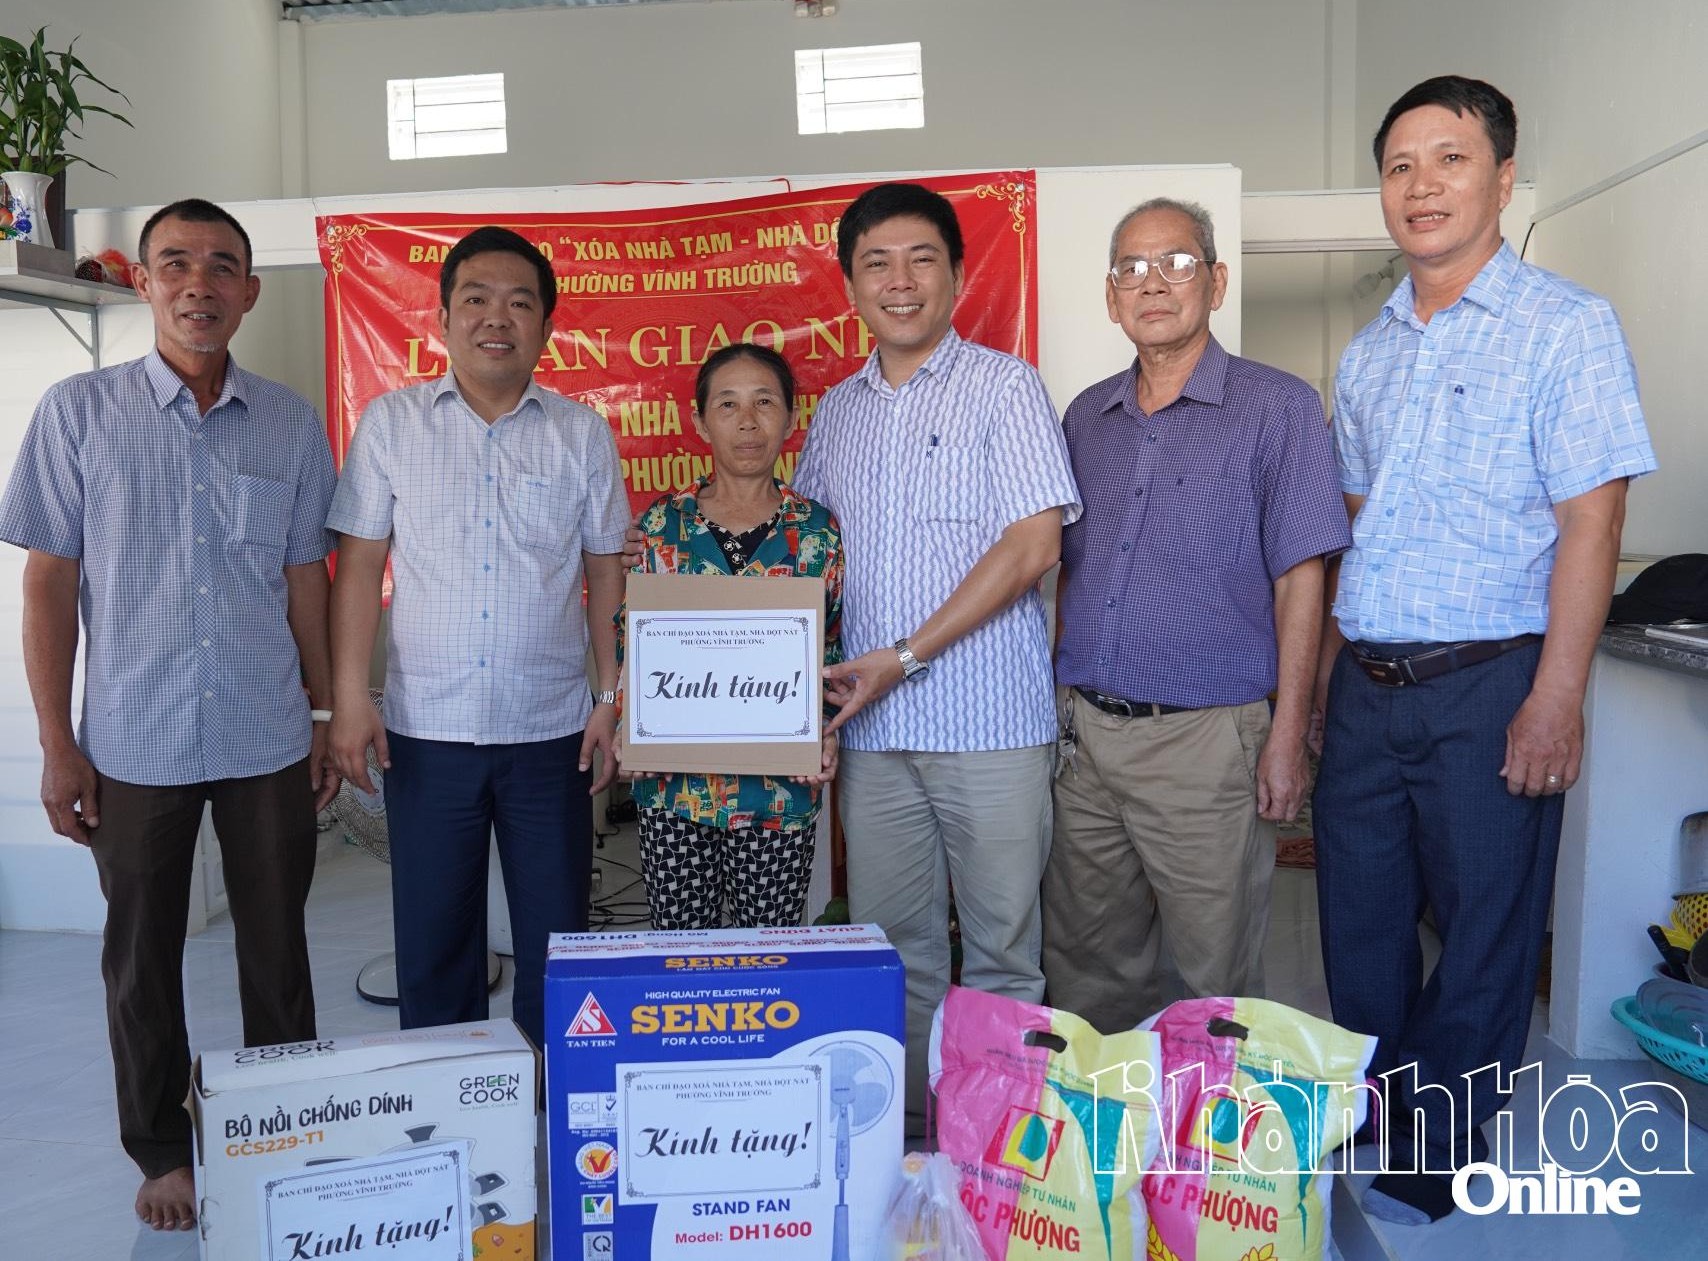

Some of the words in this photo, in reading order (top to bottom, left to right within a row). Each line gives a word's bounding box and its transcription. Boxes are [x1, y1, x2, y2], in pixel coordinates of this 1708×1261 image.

[625, 237, 676, 260] NHÀ
[680, 231, 733, 259] TẠM
[757, 220, 807, 249] NHÀ
[556, 269, 635, 294] HƯỜNG
[642, 269, 697, 292] VĨNH
[704, 260, 798, 290] TRƯỜNG
[629, 319, 785, 368] GIAO
[620, 392, 683, 437] NHÀ
[620, 447, 713, 492] PHƯỜN
[644, 671, 720, 700] Kính
[728, 670, 802, 704] tặng!
[665, 955, 789, 969] SENKO
[645, 991, 669, 1000] HIGH
[671, 989, 711, 999] QUALITY
[712, 988, 759, 998] ELECTRIC
[760, 987, 781, 996] FAN
[631, 1000, 800, 1034] SENKO
[234, 1043, 337, 1064] COOK
[566, 1040, 590, 1048] TAN
[591, 1039, 616, 1047] TIEN
[662, 1036, 687, 1046] FOR
[689, 1036, 698, 1045] A
[701, 1034, 736, 1045] COOL
[738, 1034, 765, 1043] LIFE
[459, 1073, 520, 1090] GREEN
[459, 1086, 519, 1105] COOK
[225, 1114, 252, 1143] BỘ
[259, 1105, 292, 1136] NỒI
[298, 1095, 362, 1127] CHỐNG
[368, 1092, 413, 1116] DÍNH
[225, 1130, 325, 1157] GCS229-T1
[635, 1126, 720, 1158] Kính
[730, 1121, 812, 1158] tặng!
[278, 1189, 295, 1199] BAN
[692, 1200, 750, 1217] STAND
[756, 1198, 791, 1213] FAN
[1181, 1183, 1279, 1233] PHƯỢNG
[279, 1224, 366, 1261] Kính
[375, 1205, 454, 1249] tặng!
[675, 1231, 724, 1244] Model:
[729, 1221, 812, 1241] DH1600
[993, 1201, 1081, 1253] PHƯỢNG
